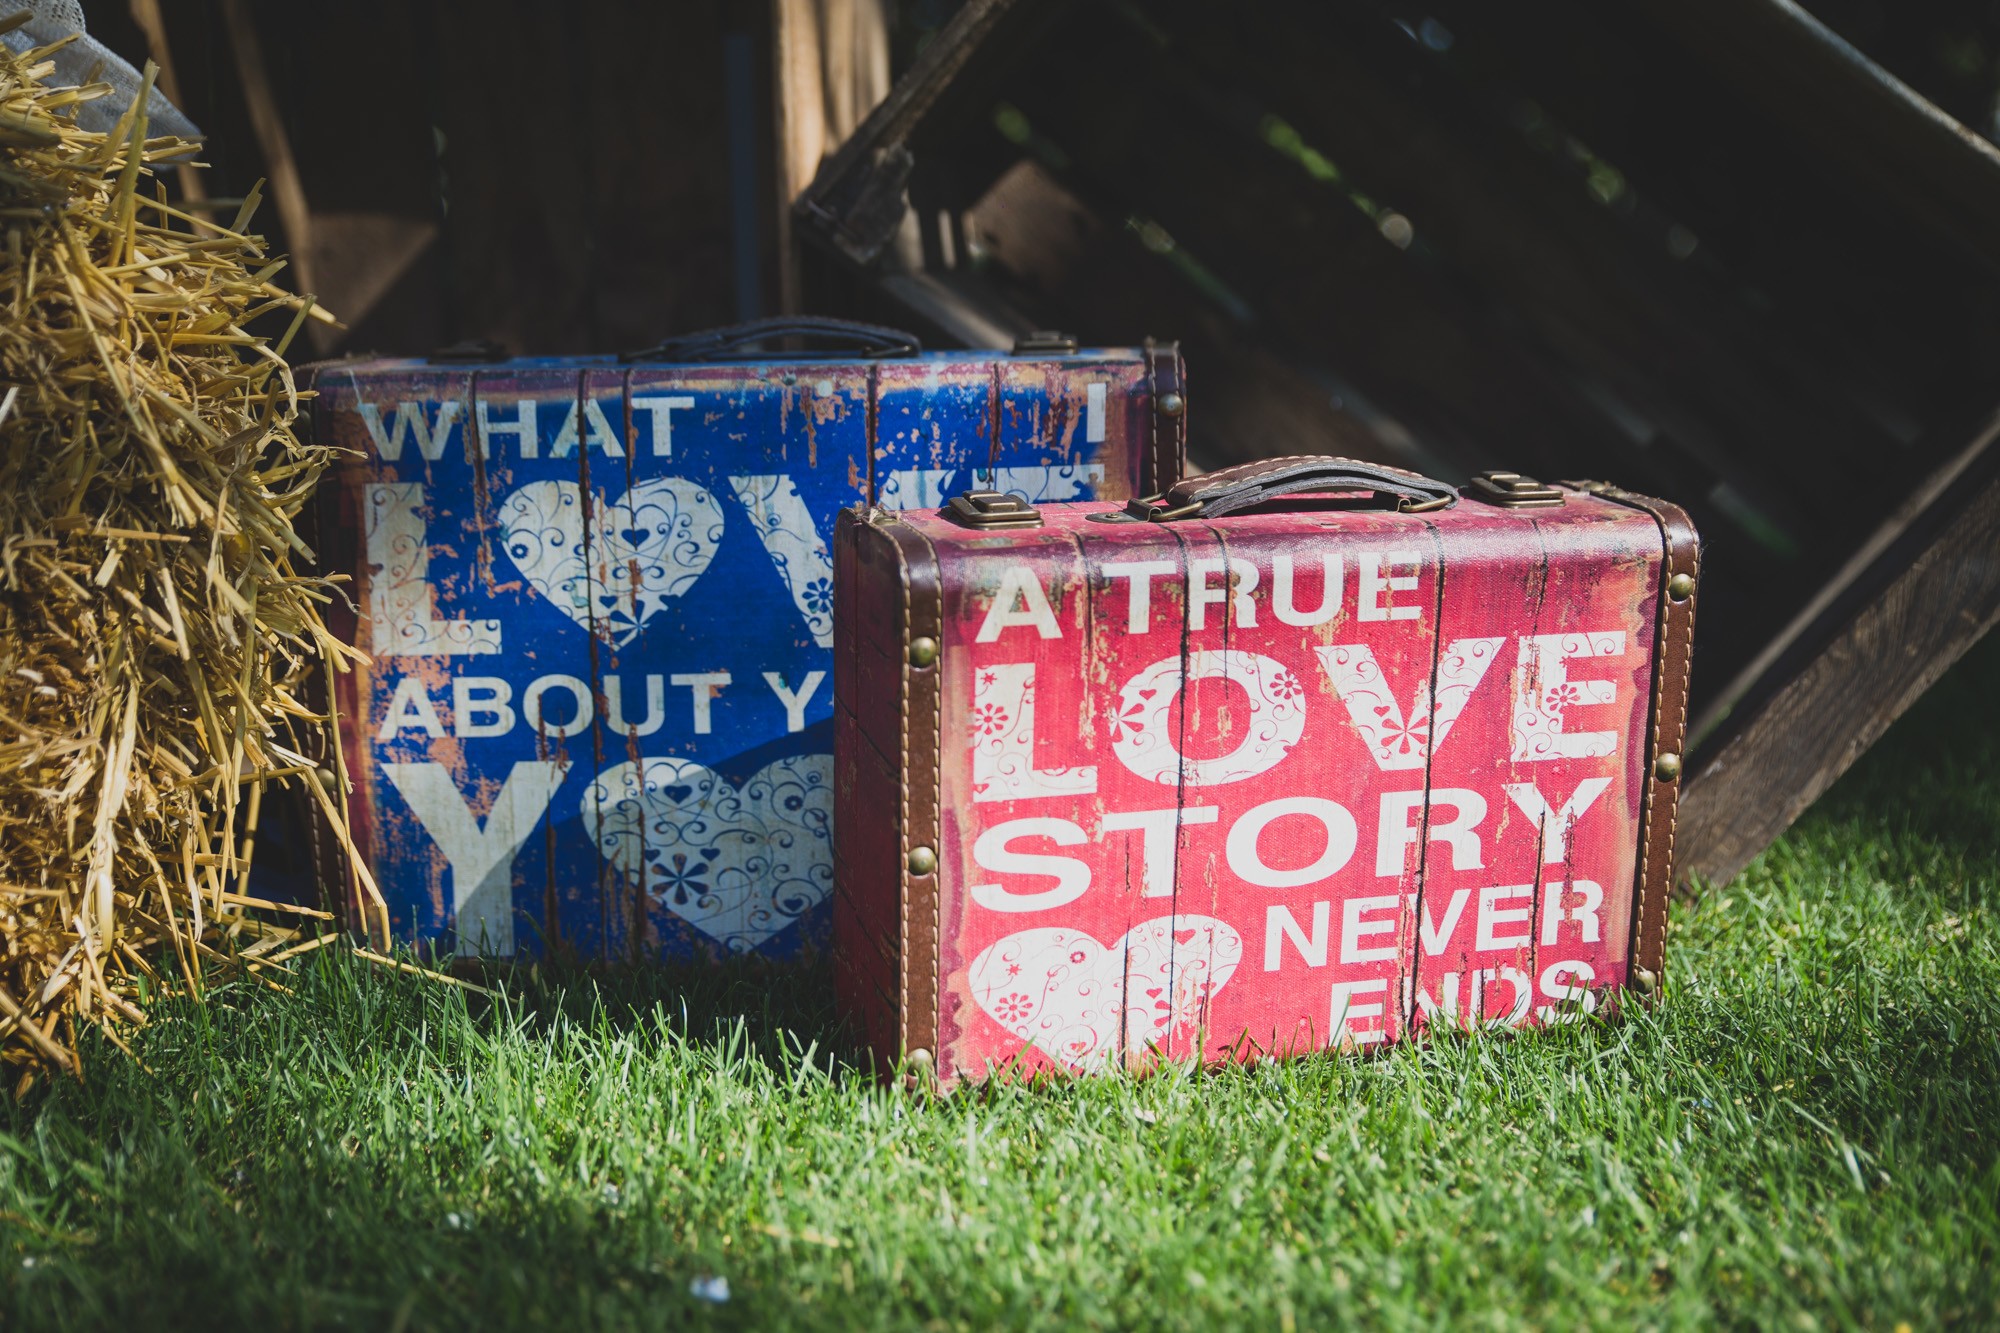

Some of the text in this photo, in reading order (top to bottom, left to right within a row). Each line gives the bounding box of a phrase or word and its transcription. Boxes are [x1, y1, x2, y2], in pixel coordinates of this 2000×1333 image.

[359, 396, 695, 461] WHAT
[975, 550, 1422, 643] A TRUE
[380, 670, 835, 741] ABOUT Y
[973, 630, 1626, 803] LOVE
[970, 776, 1613, 913] STORY
[1263, 879, 1604, 972] NEVER
[1328, 960, 1596, 1047] ENDS
